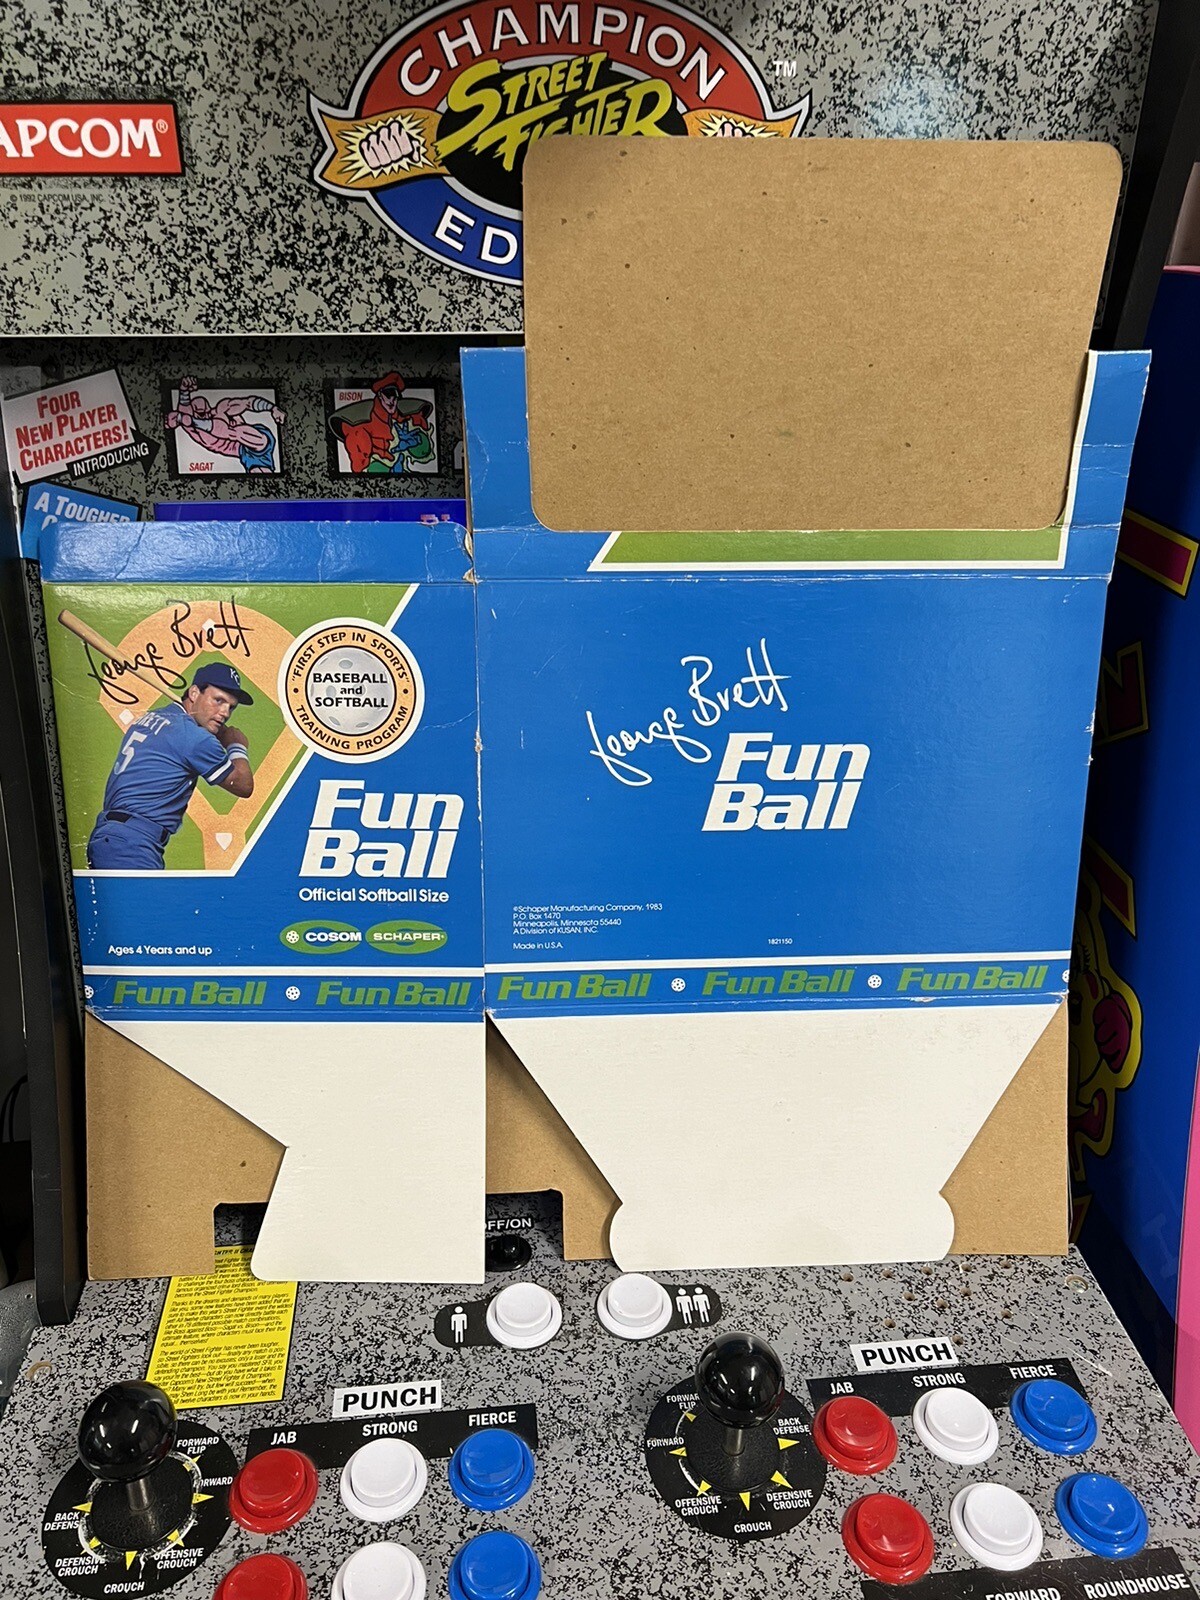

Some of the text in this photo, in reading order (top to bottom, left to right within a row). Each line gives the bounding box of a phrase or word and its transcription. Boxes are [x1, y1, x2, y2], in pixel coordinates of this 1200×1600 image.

[400, 4, 727, 100] CHAMPION
[773, 60, 797, 77] TM
[431, 52, 608, 162] STREET
[469, 78, 673, 172] FIGHTER
[19, 193, 36, 202] 1992
[37, 193, 70, 202] CAPCOM
[338, 391, 363, 401] BISON
[36, 390, 82, 419] FOUR
[15, 403, 118, 449] NEW PLAYER
[19, 419, 130, 472] CHARACTERS!
[73, 442, 150, 477] INTRODUCING
[189, 462, 214, 472] SAGAT
[33, 491, 50, 513] A
[165, 595, 255, 658] Brett
[316, 631, 347, 649] STEP
[351, 632, 367, 643] IN
[312, 672, 388, 684] BASEBALL
[680, 637, 792, 726] Brett
[340, 685, 363, 695] and
[314, 697, 389, 708] SOFTBALL
[295, 704, 409, 750] TRAINING PROGRAM
[114, 731, 148, 775] 5
[716, 732, 870, 782] Fun
[310, 779, 464, 829] Fun
[701, 781, 862, 832] Ball
[299, 829, 458, 878] Ball
[299, 887, 450, 903] Official Softball Size
[550, 904, 604, 912] Manufacturing
[645, 902, 663, 911] 1983
[528, 912, 542, 920] Box
[543, 911, 561, 919] 1470
[560, 919, 599, 927] Minnesota
[599, 918, 622, 926] 55440
[305, 931, 363, 943] COSOM
[513, 927, 519, 935] A
[520, 927, 548, 935] Division
[108, 944, 212, 956] Ages 4 Years and up
[513, 942, 536, 950] Made
[702, 968, 855, 996] Fun Ball
[898, 965, 1050, 991] Fun Ball
[113, 980, 268, 1005] Fun Ball
[315, 980, 472, 1006] Fun Ball
[498, 973, 652, 1000] Fun Ball
[485, 1217, 532, 1231] FF/ON
[861, 1342, 953, 1367] PUNCH
[829, 1364, 1057, 1395] JAB STRONG FIERCE
[342, 1386, 437, 1412] PUNCH
[666, 1393, 700, 1403] FORWAR
[679, 1401, 696, 1410] FLIP
[270, 1411, 517, 1446] JAB STRONG FIERCE
[778, 1417, 800, 1427] BACK
[773, 1424, 810, 1436] DEFENSE
[176, 1436, 220, 1448] FORWARD
[647, 1437, 684, 1448] FORWARD
[187, 1446, 206, 1455] FLIP
[675, 1495, 722, 1508] OFFENSIVE
[766, 1489, 813, 1502] DEFENSIVE
[681, 1505, 719, 1517] CROUCH
[773, 1499, 811, 1511] CROUCH
[54, 1512, 80, 1522] BACK
[44, 1521, 80, 1531] DEFENS
[734, 1521, 772, 1534] CROUCH
[55, 1555, 105, 1568] DEFENSIVE
[156, 1558, 197, 1570] CROUCH
[57, 1565, 99, 1577] CROUCH
[104, 1581, 145, 1594] CROUCH
[1083, 1573, 1190, 1599] ROUNDHOUSE
